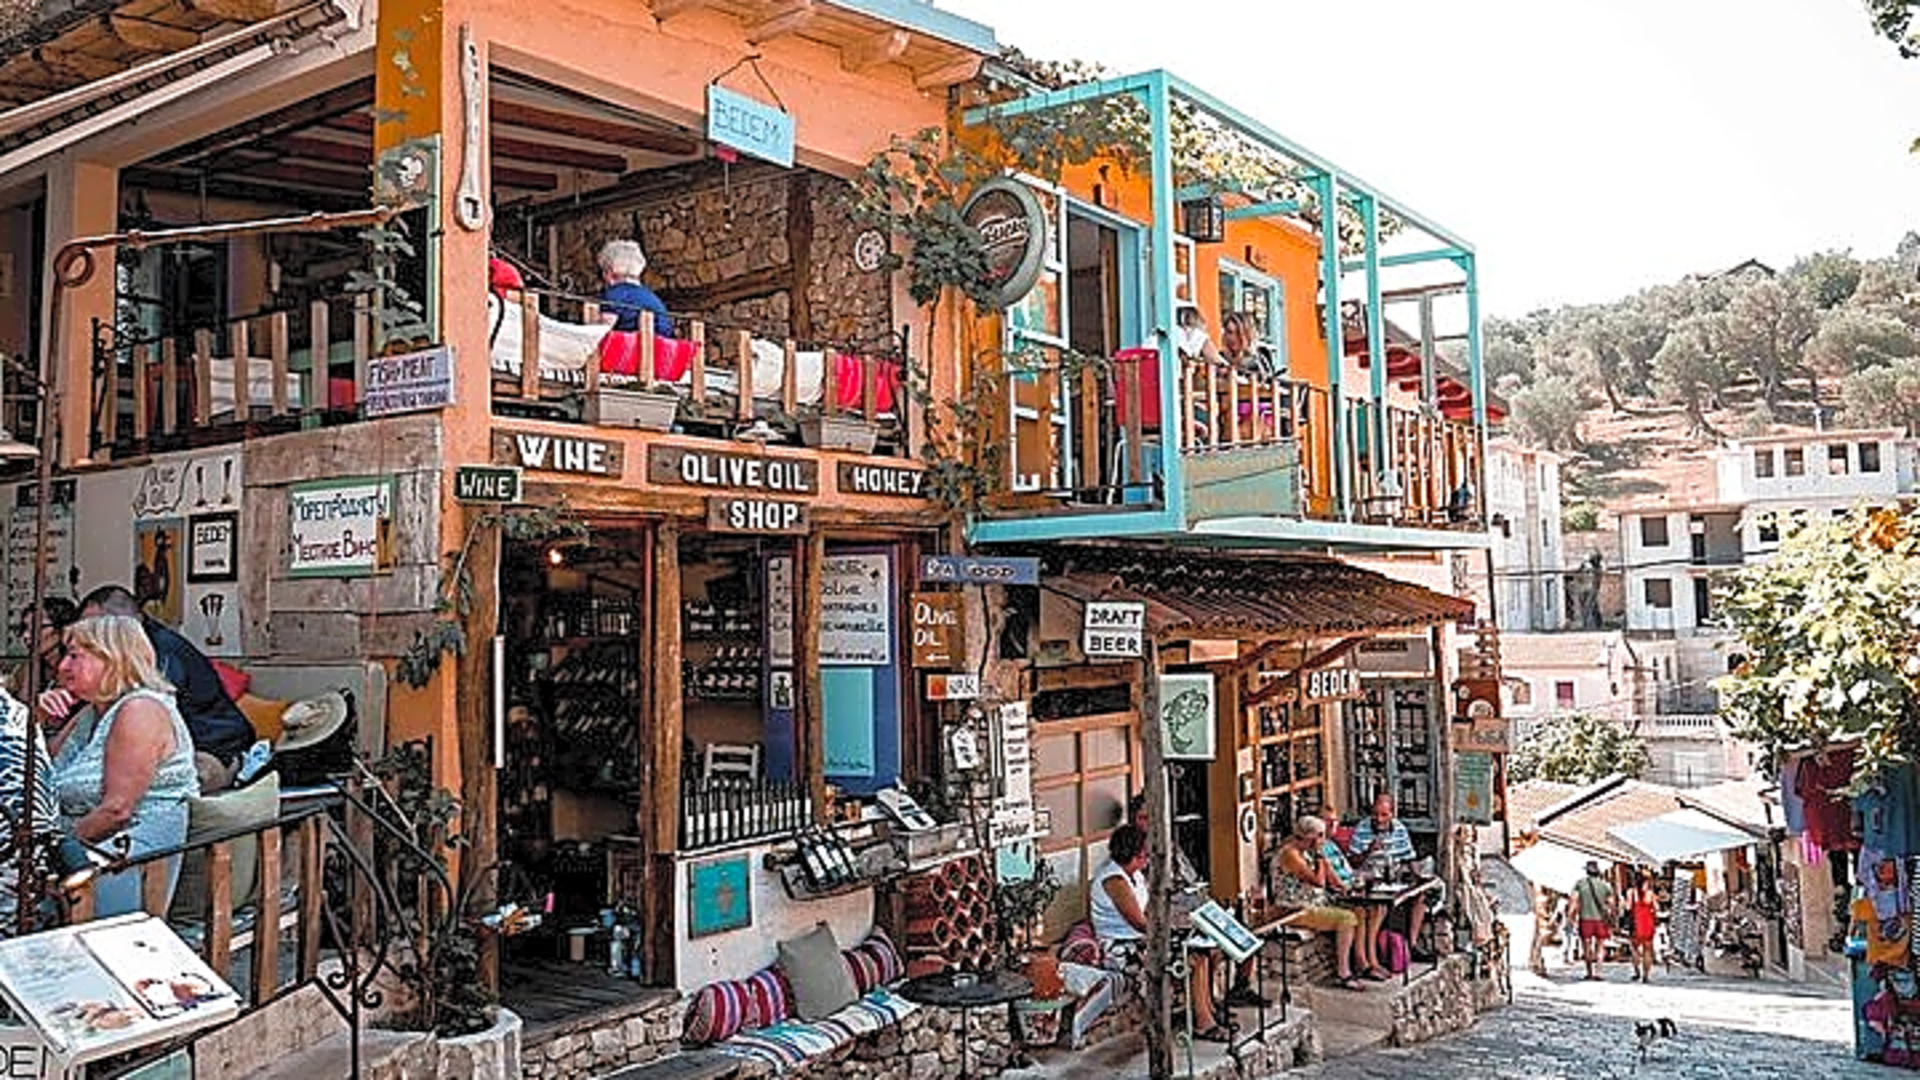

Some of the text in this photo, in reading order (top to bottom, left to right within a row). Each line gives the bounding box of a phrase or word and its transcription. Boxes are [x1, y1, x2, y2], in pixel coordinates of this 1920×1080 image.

[516, 434, 607, 472] WINE
[681, 453, 809, 491] OLIVE OIL
[460, 473, 511, 497] WINE
[729, 502, 799, 529] SHOP
[914, 602, 958, 625] OLIVE
[1089, 607, 1142, 625] DRAFT
[914, 629, 942, 647] OIL
[1088, 636, 1140, 654] BEER
